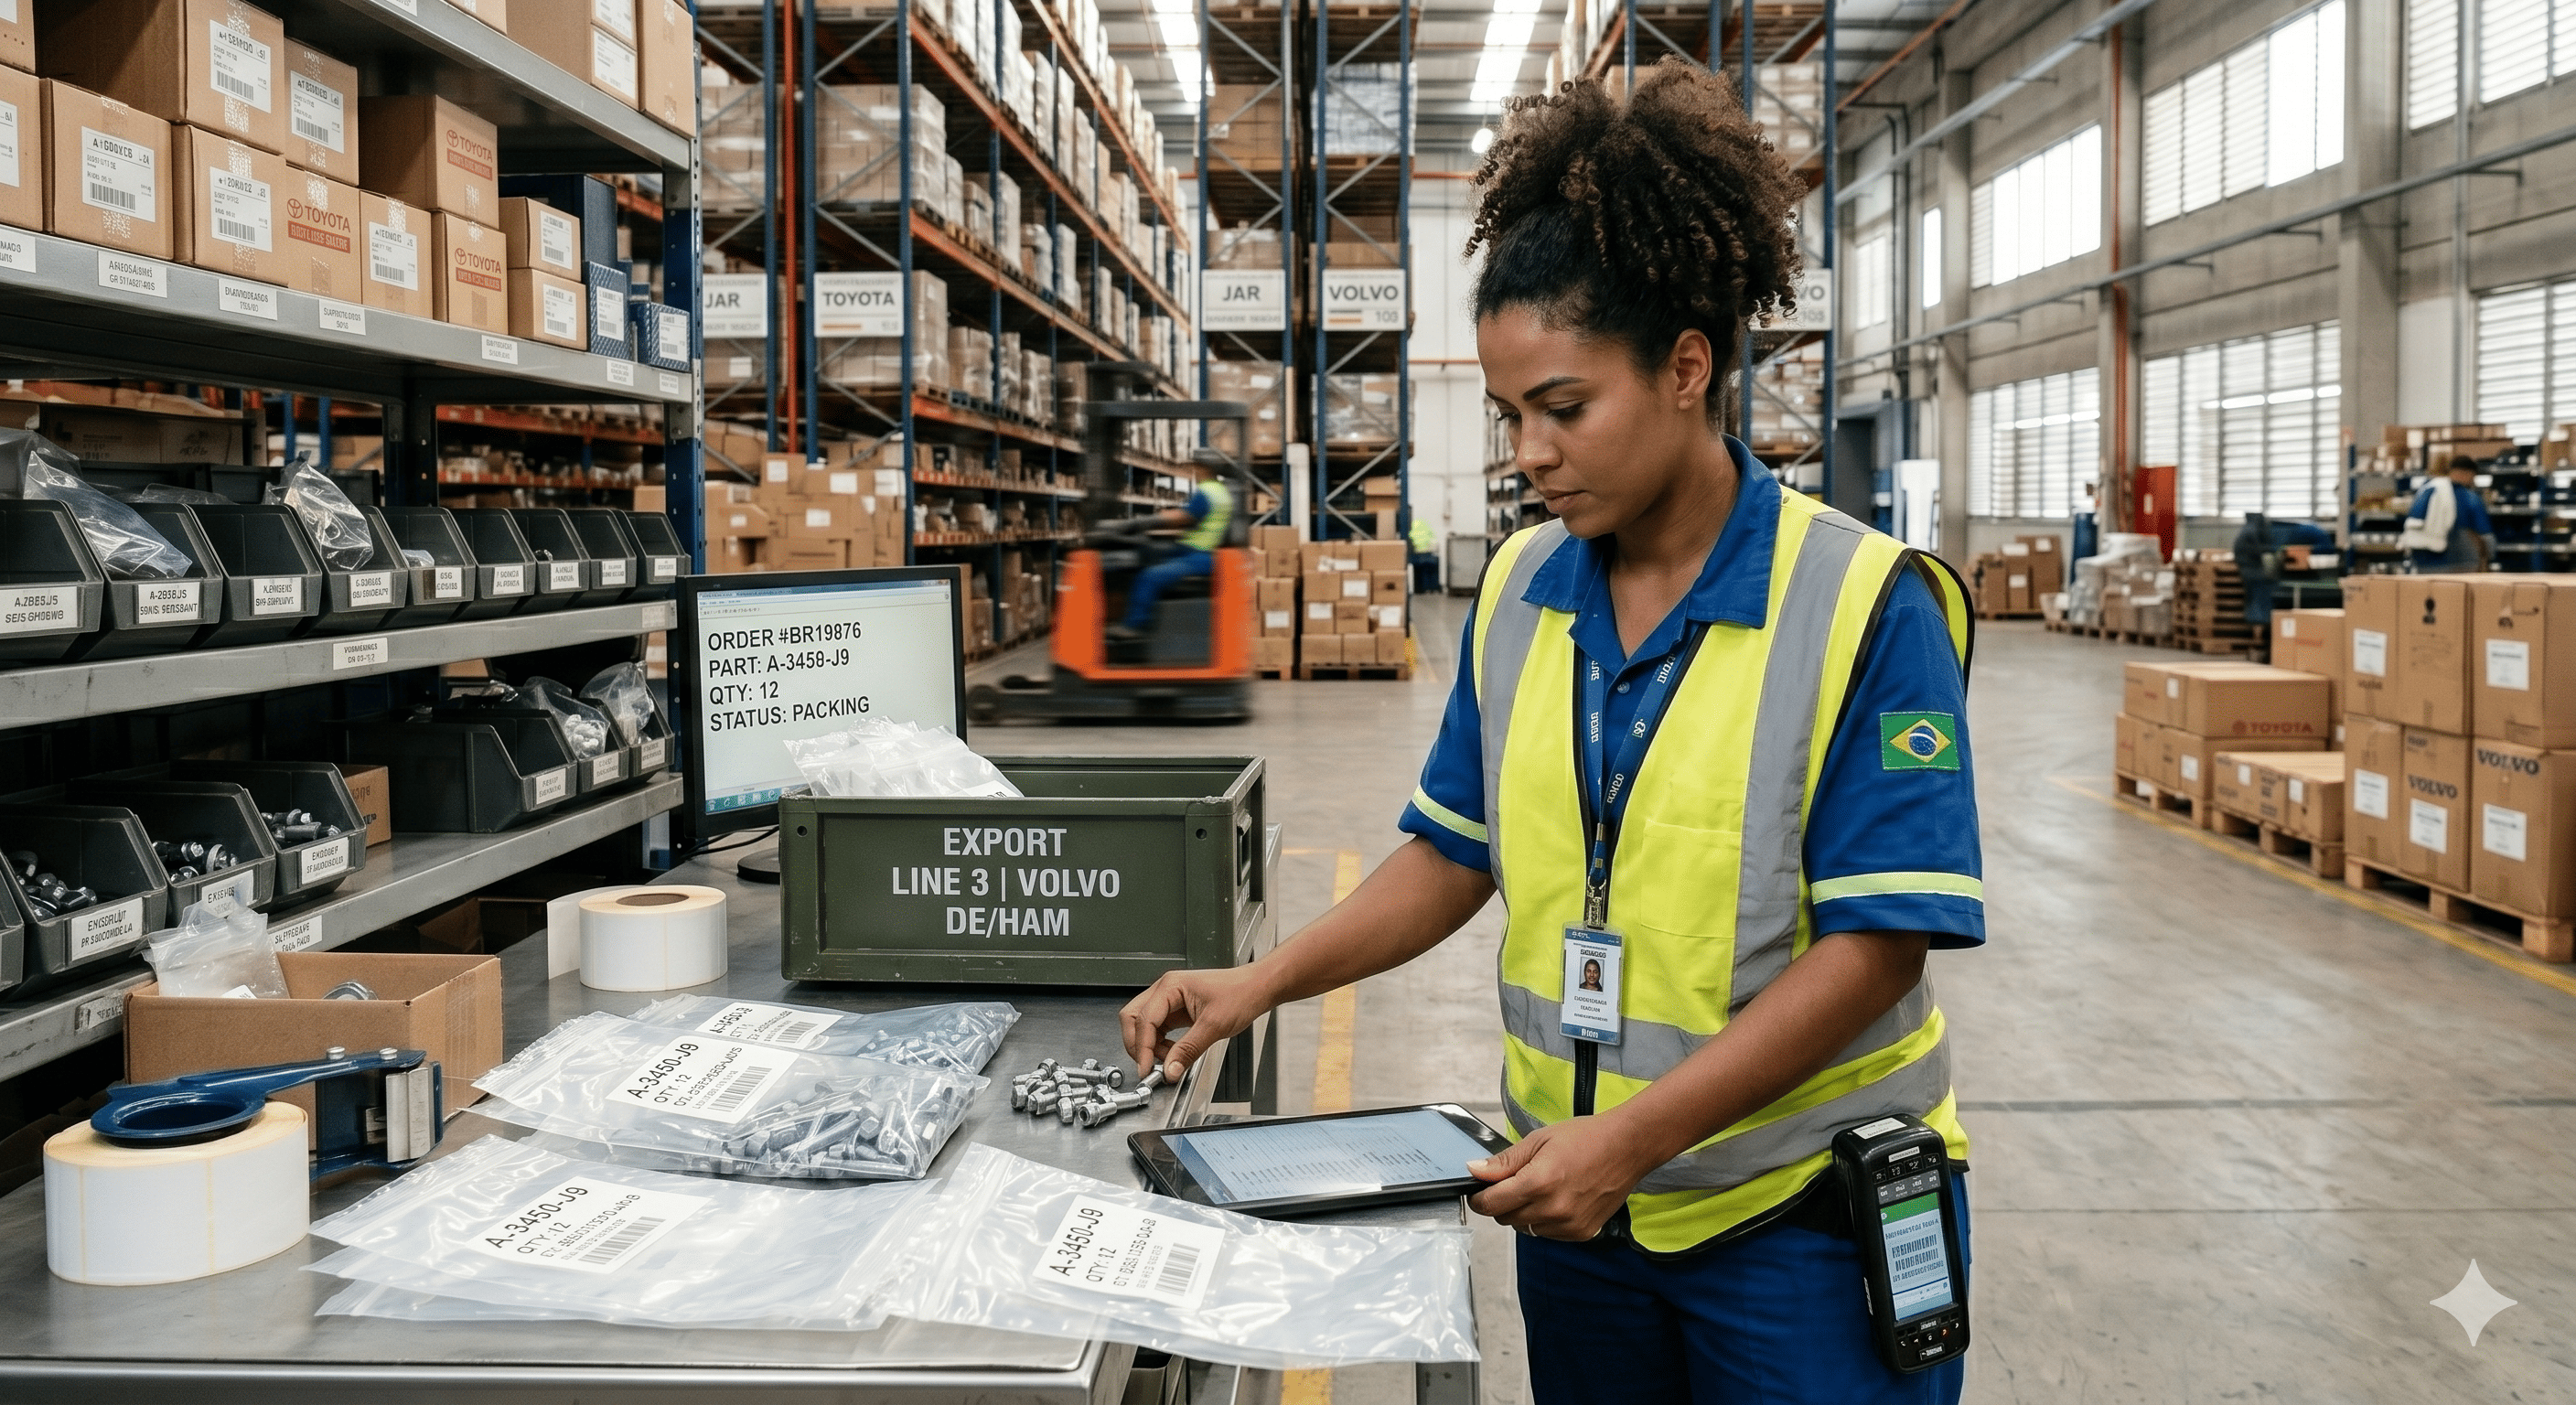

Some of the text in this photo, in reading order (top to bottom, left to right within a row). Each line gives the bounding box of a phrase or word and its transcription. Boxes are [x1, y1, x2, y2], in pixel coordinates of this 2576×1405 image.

[459, 135, 493, 163] TOYOTA
[305, 205, 351, 233] TOYOTA
[467, 252, 502, 274] TOYOTA
[704, 293, 741, 308] JAR
[821, 292, 895, 306] TOYOTA
[1222, 285, 1261, 301] JAR
[1328, 285, 1399, 302] VOLVO
[707, 621, 862, 651] ORDER #BR19876
[709, 648, 850, 678] PART: A-3458-J9
[709, 681, 779, 705] QTY: 12
[710, 695, 870, 733] STATUS: PACKING
[2249, 721, 2313, 735] TOYOTA
[2476, 747, 2540, 776] VOLVO
[2408, 774, 2458, 799] VOLVO
[943, 827, 1068, 857] EXPORT
[892, 867, 961, 896] LINE
[971, 867, 990, 896] 3
[1017, 868, 1122, 898] VOLVO
[945, 906, 1070, 938] DE/HAM
[627, 1043, 699, 1099] A-3450-J9
[675, 1074, 692, 1083] 12
[485, 1186, 588, 1249] A-3450-J9
[1049, 1207, 1103, 1277] A-3450-J9
